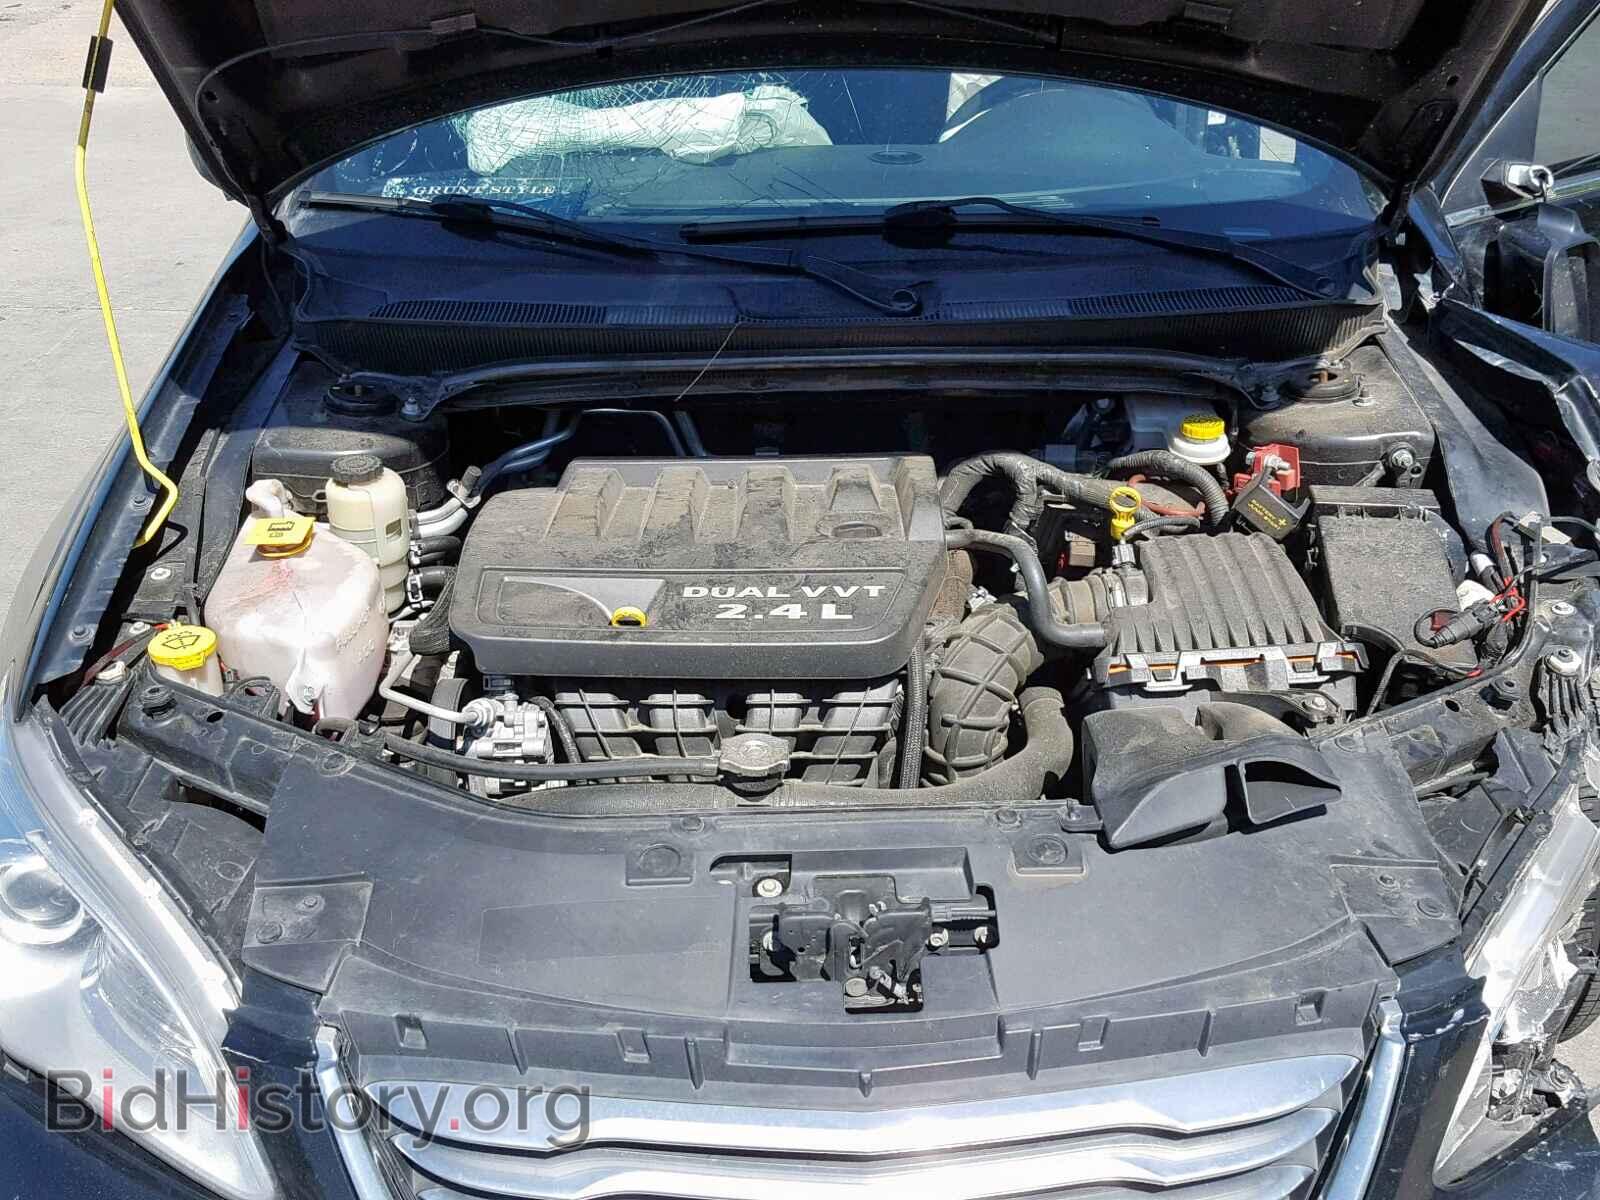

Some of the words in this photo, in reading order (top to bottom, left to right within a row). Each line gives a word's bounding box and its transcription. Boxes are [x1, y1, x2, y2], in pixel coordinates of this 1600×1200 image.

[413, 184, 484, 196] GRUNT
[489, 184, 556, 195] STYLE
[681, 586, 791, 598] DUAL
[800, 585, 887, 598] VVT
